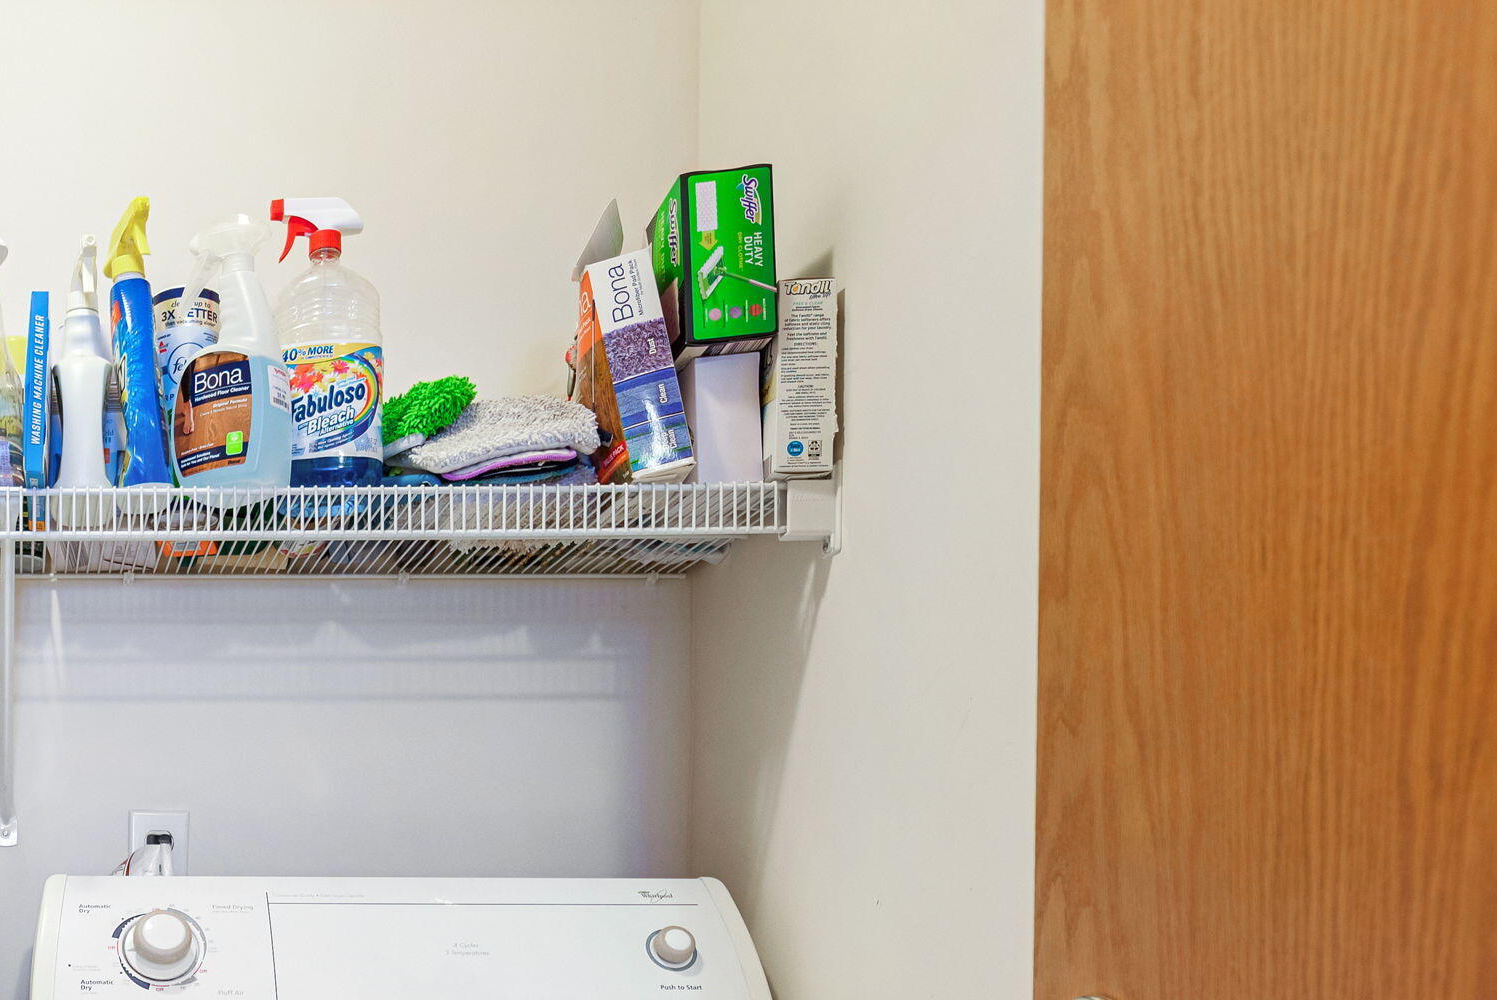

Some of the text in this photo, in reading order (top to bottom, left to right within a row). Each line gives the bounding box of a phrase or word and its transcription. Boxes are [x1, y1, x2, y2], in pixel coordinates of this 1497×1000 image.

[740, 174, 760, 224] Swiffer
[669, 199, 678, 267] Swiffer
[744, 236, 752, 265] DUTY
[754, 232, 764, 266] HEAVY
[608, 263, 634, 323] Bona
[634, 286, 644, 316] Microfiber
[162, 308, 218, 323] 3X ETTER
[283, 348, 306, 362] 40%
[308, 346, 334, 355] MORE
[649, 338, 658, 354] Dust
[30, 315, 44, 444] WASHING MACHINE CLEANER
[194, 368, 244, 394] Bona
[194, 392, 216, 402] Hardwood
[292, 383, 365, 423] Fabuloso
[658, 384, 666, 404] Clean
[307, 405, 355, 435] Bleach
[319, 420, 354, 436] Alternative
[613, 444, 624, 456] PACK
[669, 430, 678, 448] Clean
[641, 890, 673, 902] Whirlpool
